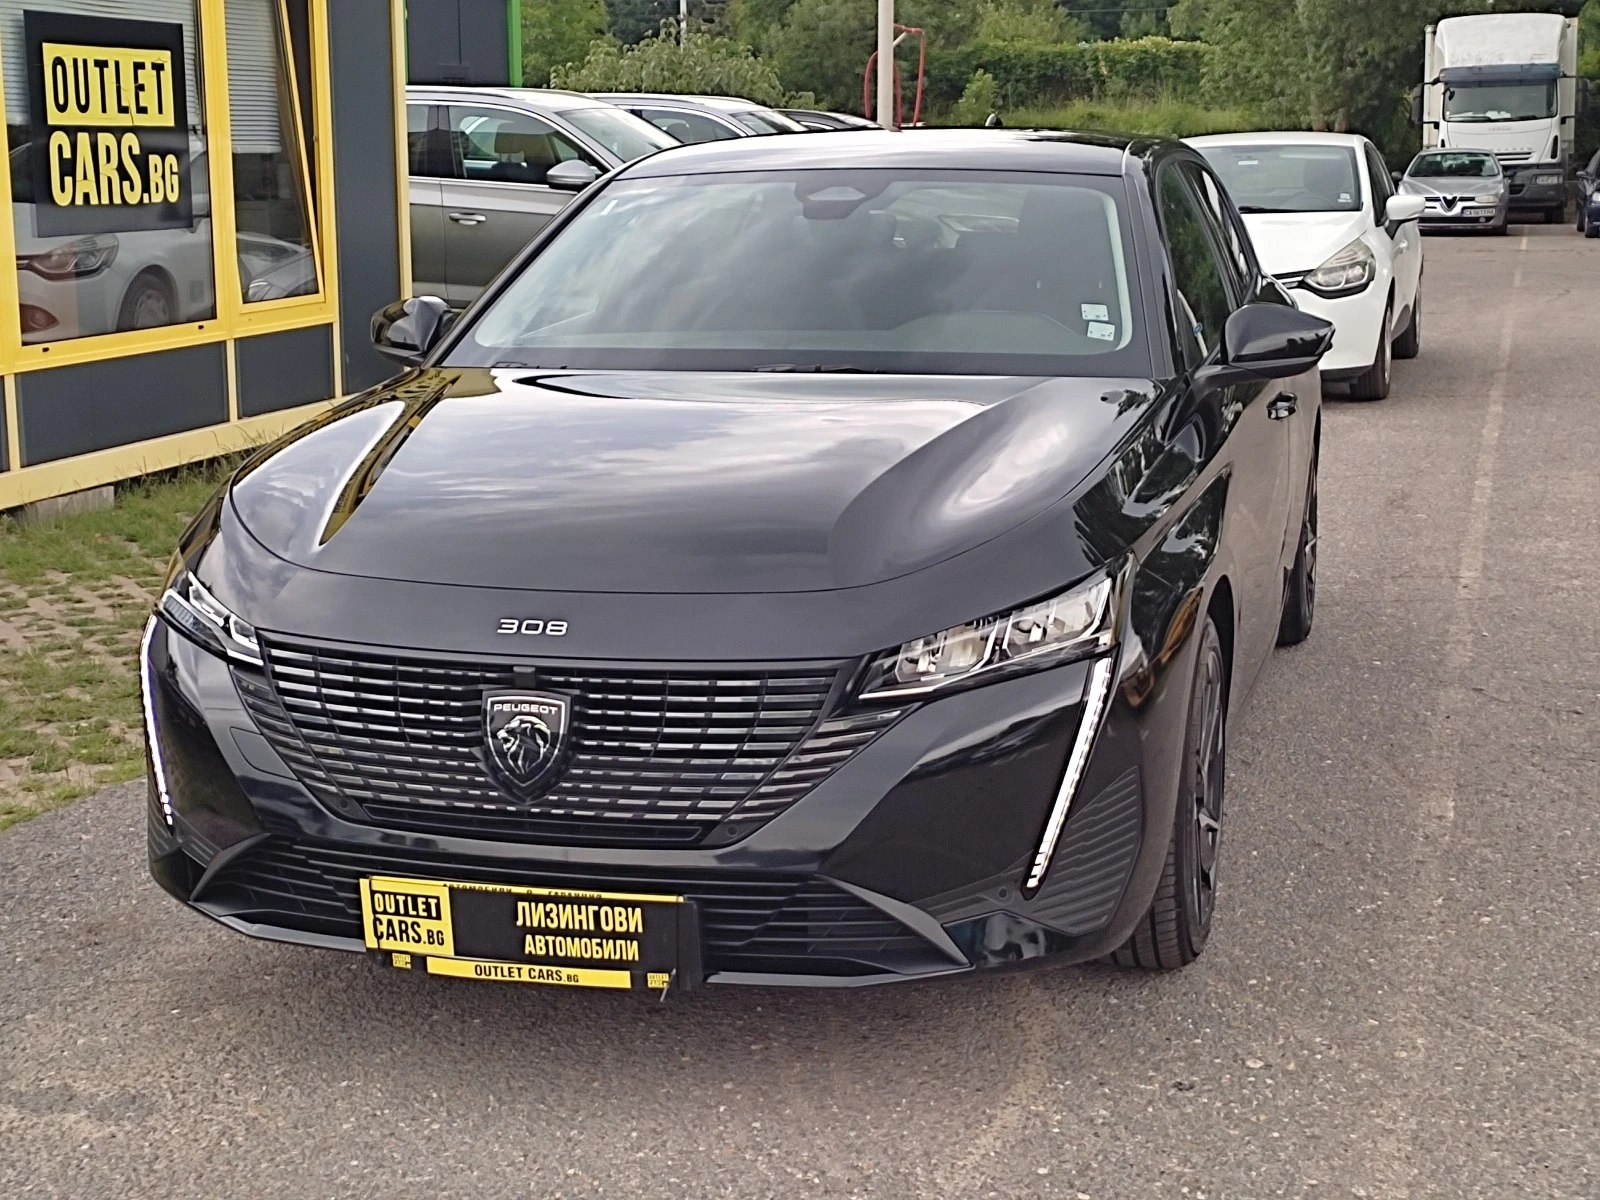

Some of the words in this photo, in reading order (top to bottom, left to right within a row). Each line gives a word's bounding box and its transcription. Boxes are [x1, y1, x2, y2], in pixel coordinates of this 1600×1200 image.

[52, 56, 165, 115] OUTLET
[49, 131, 179, 206] CARS.BG
[497, 619, 568, 636] 308
[494, 703, 558, 715] PEUGEOT
[374, 893, 437, 918] OUTLET
[516, 901, 644, 933] ЛИЗИНГОВИ
[373, 917, 444, 946] CARS.BG
[524, 934, 639, 962] АВТОМОБИЛИ
[475, 964, 523, 979] OUTLET
[528, 967, 580, 983] CARS.BG
